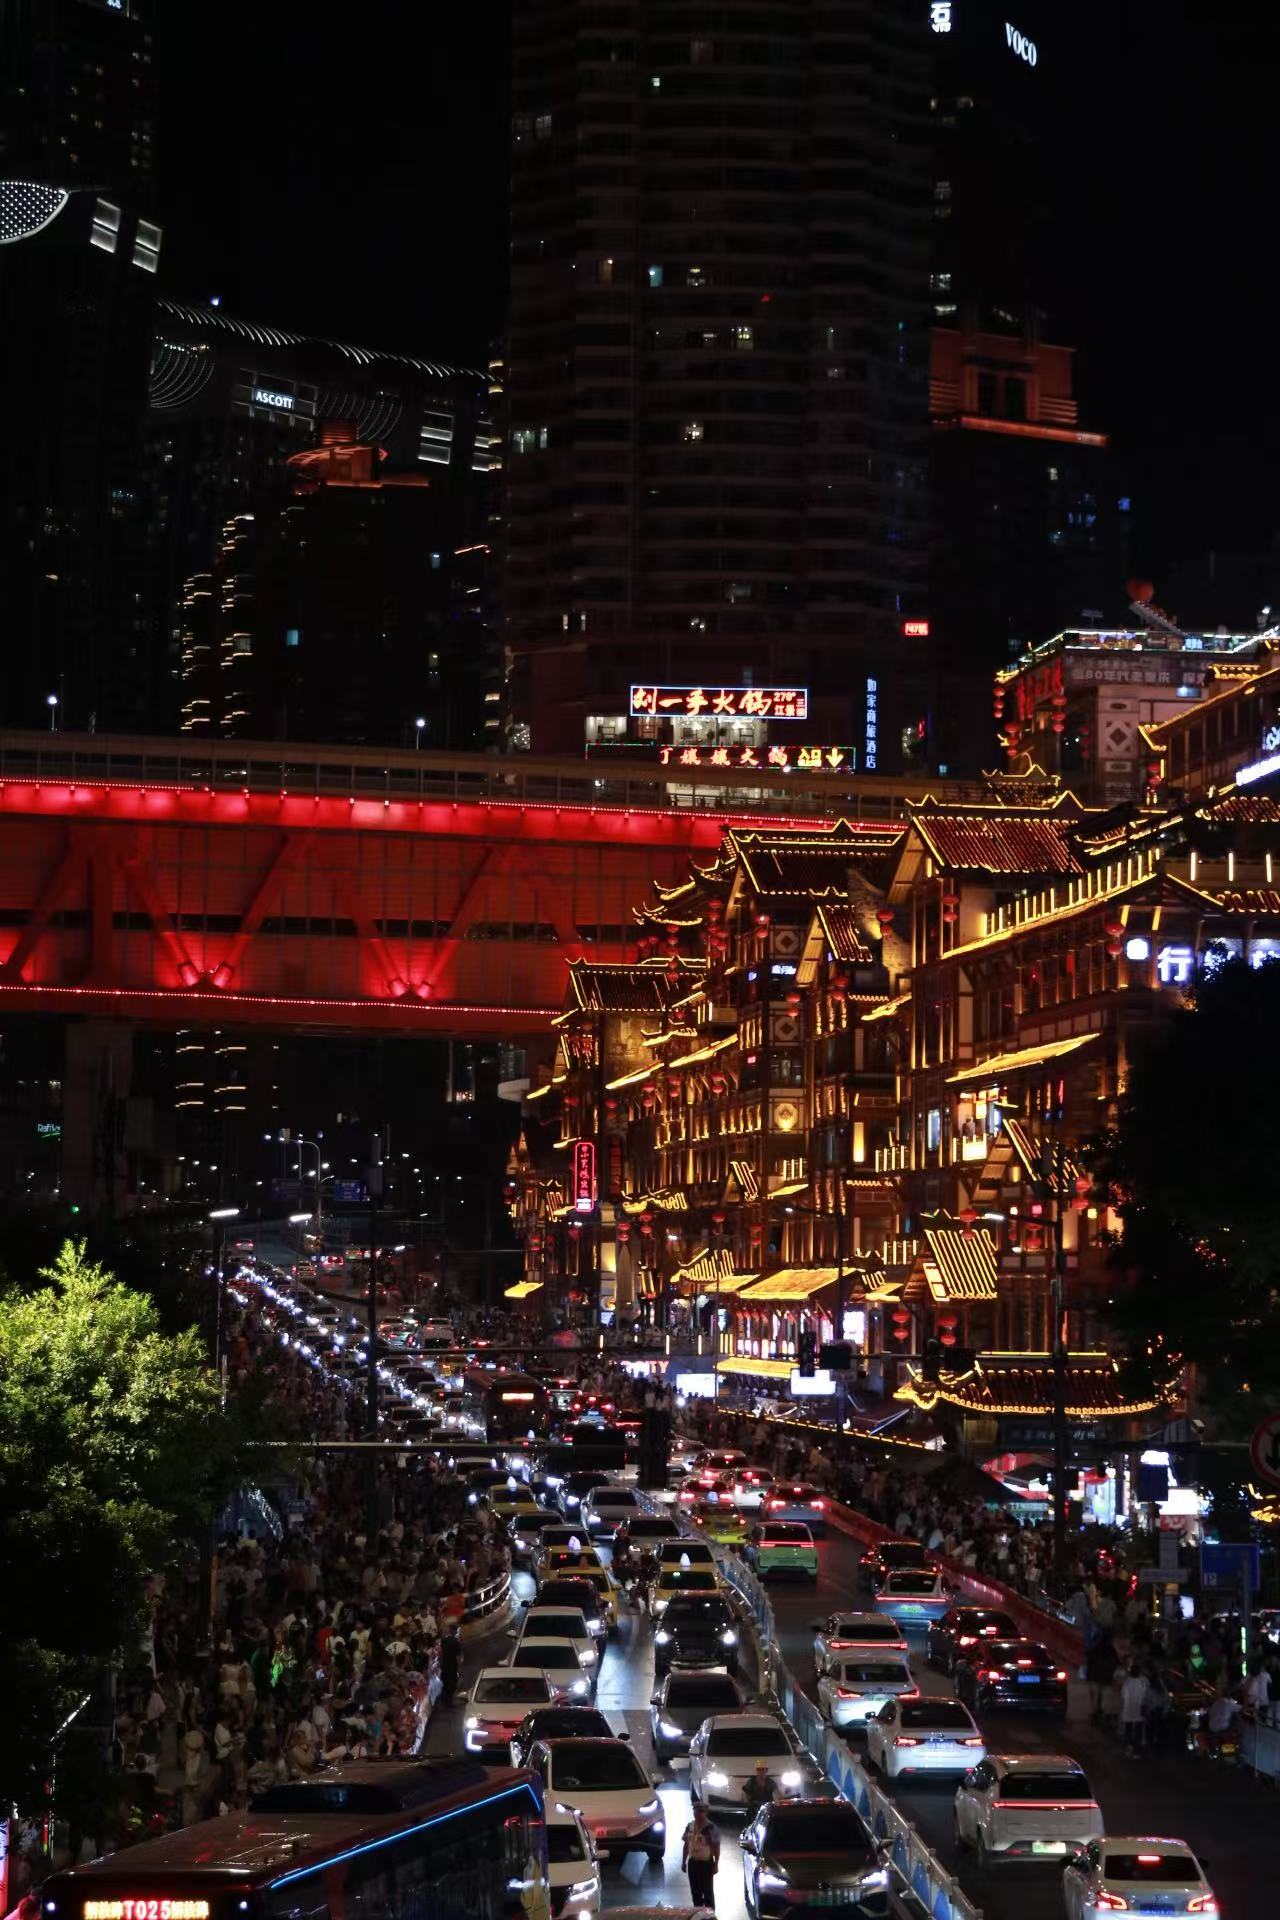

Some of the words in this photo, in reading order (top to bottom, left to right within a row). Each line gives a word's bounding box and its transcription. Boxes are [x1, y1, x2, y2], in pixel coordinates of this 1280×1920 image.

[255, 391, 293, 409] ASCOTT
[866, 679, 877, 769] 如家商旅酒店
[124, 1900, 171, 1920] T025
